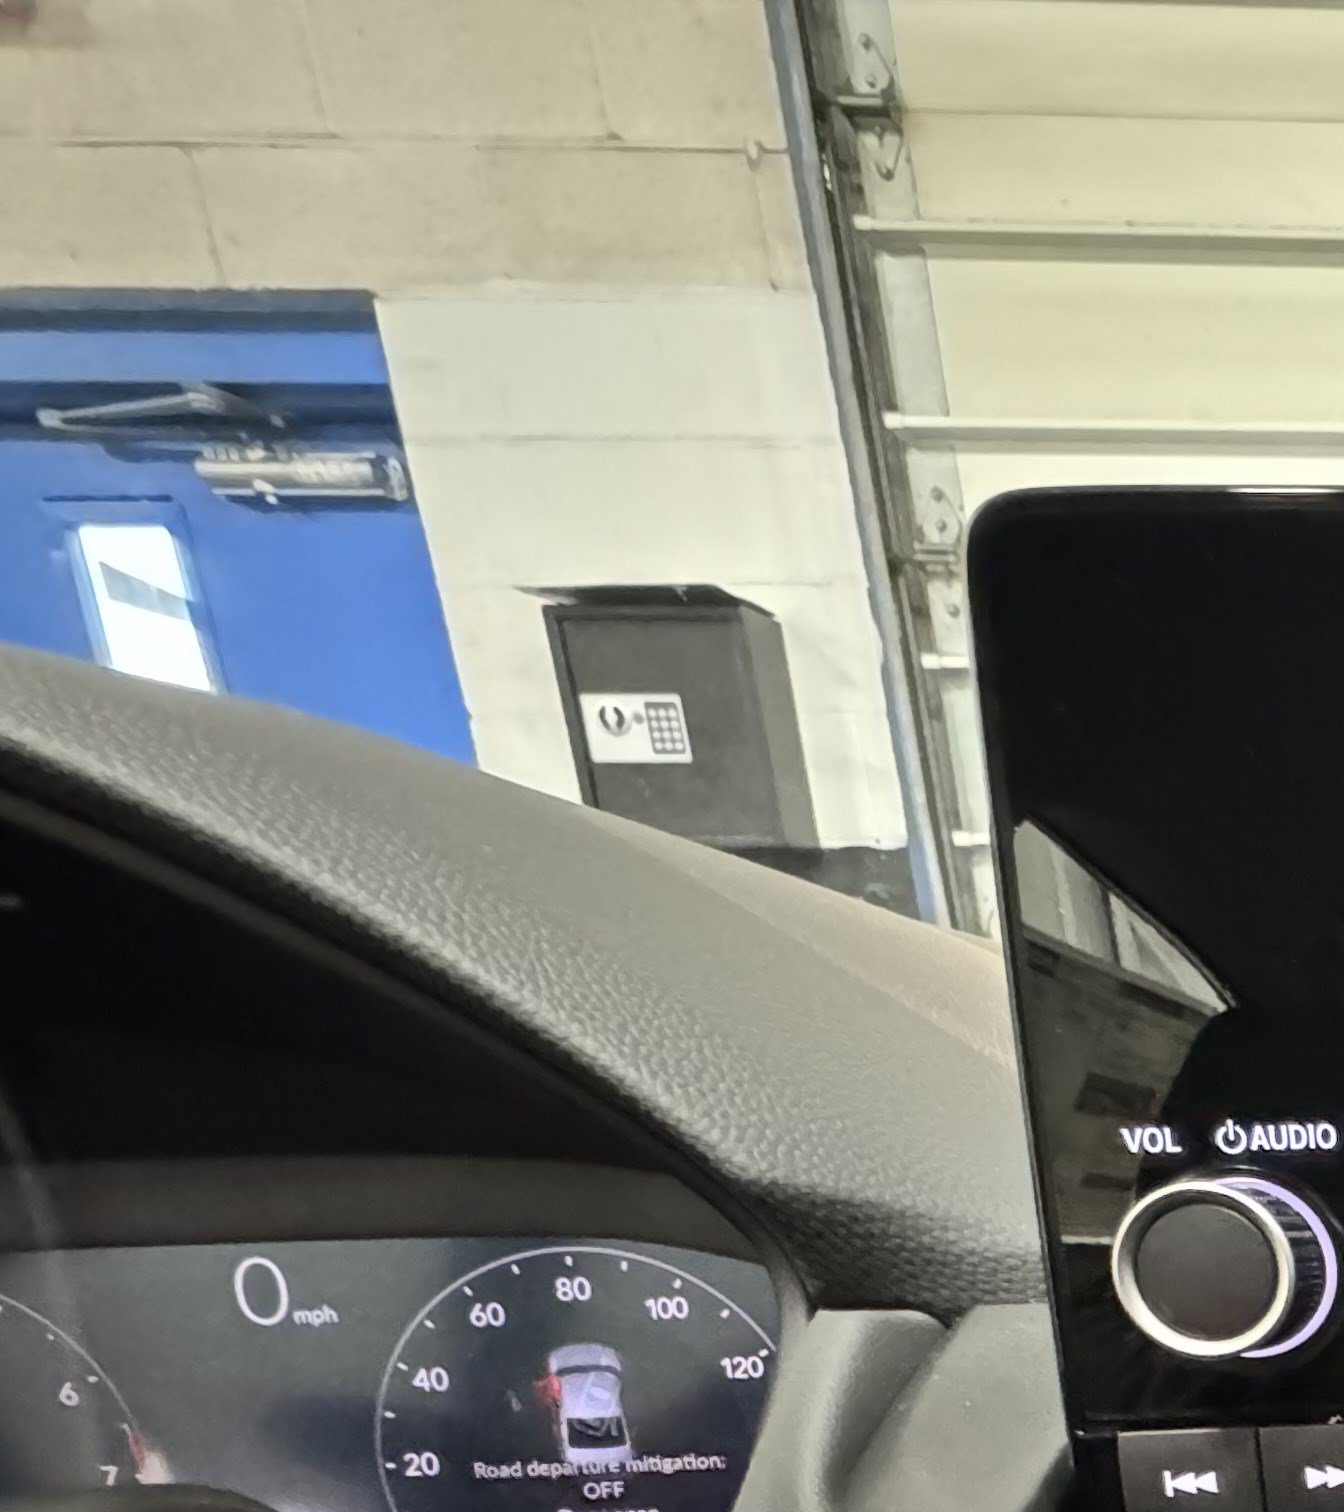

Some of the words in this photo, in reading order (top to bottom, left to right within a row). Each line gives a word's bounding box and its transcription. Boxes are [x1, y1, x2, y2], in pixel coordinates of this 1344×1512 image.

[1121, 1126, 1183, 1154] VOL
[1250, 1122, 1339, 1152] AUDIO
[233, 1256, 289, 1327] 0
[292, 1304, 340, 1327] mph
[555, 1275, 593, 1303] 80
[469, 1302, 506, 1328] 60
[644, 1296, 690, 1320] 100
[411, 1366, 450, 1393] 40
[720, 1355, 764, 1380] 120
[58, 1381, 80, 1407] 6
[98, 1464, 119, 1487] 7
[403, 1451, 441, 1478] 20
[473, 1460, 524, 1480] Road
[526, 1457, 621, 1479] departure
[583, 1480, 625, 1500] OFF
